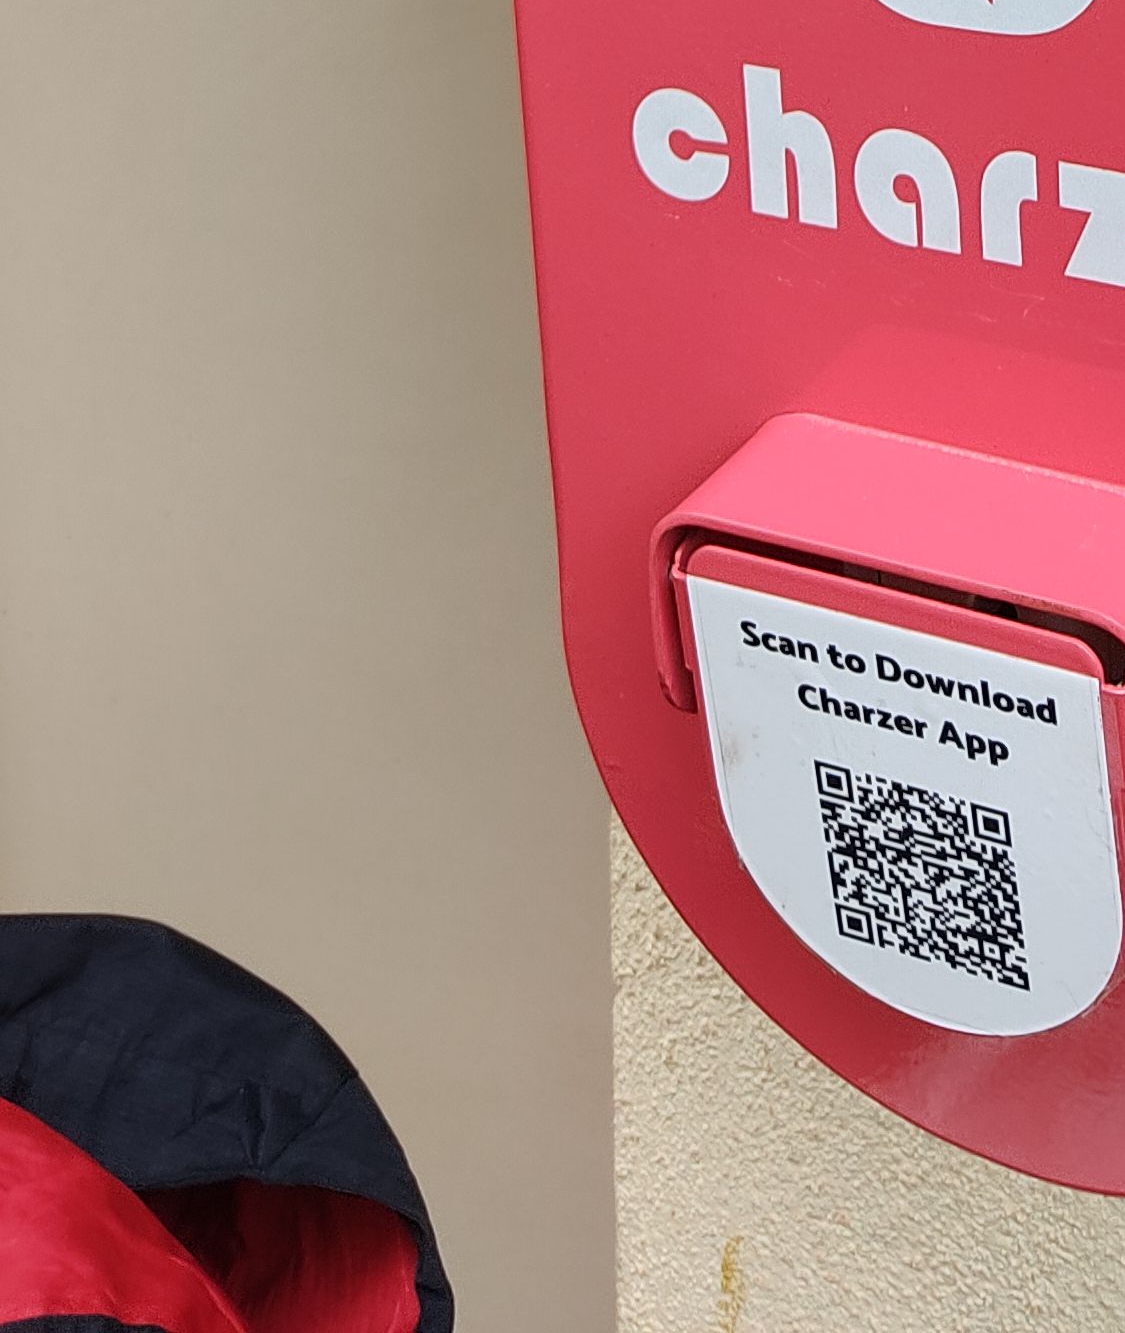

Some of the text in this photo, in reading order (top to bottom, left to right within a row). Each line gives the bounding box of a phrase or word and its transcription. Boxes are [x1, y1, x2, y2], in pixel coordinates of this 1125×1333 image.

[739, 620, 1058, 726] Scan to Download
[797, 684, 1010, 766] Charzer App
